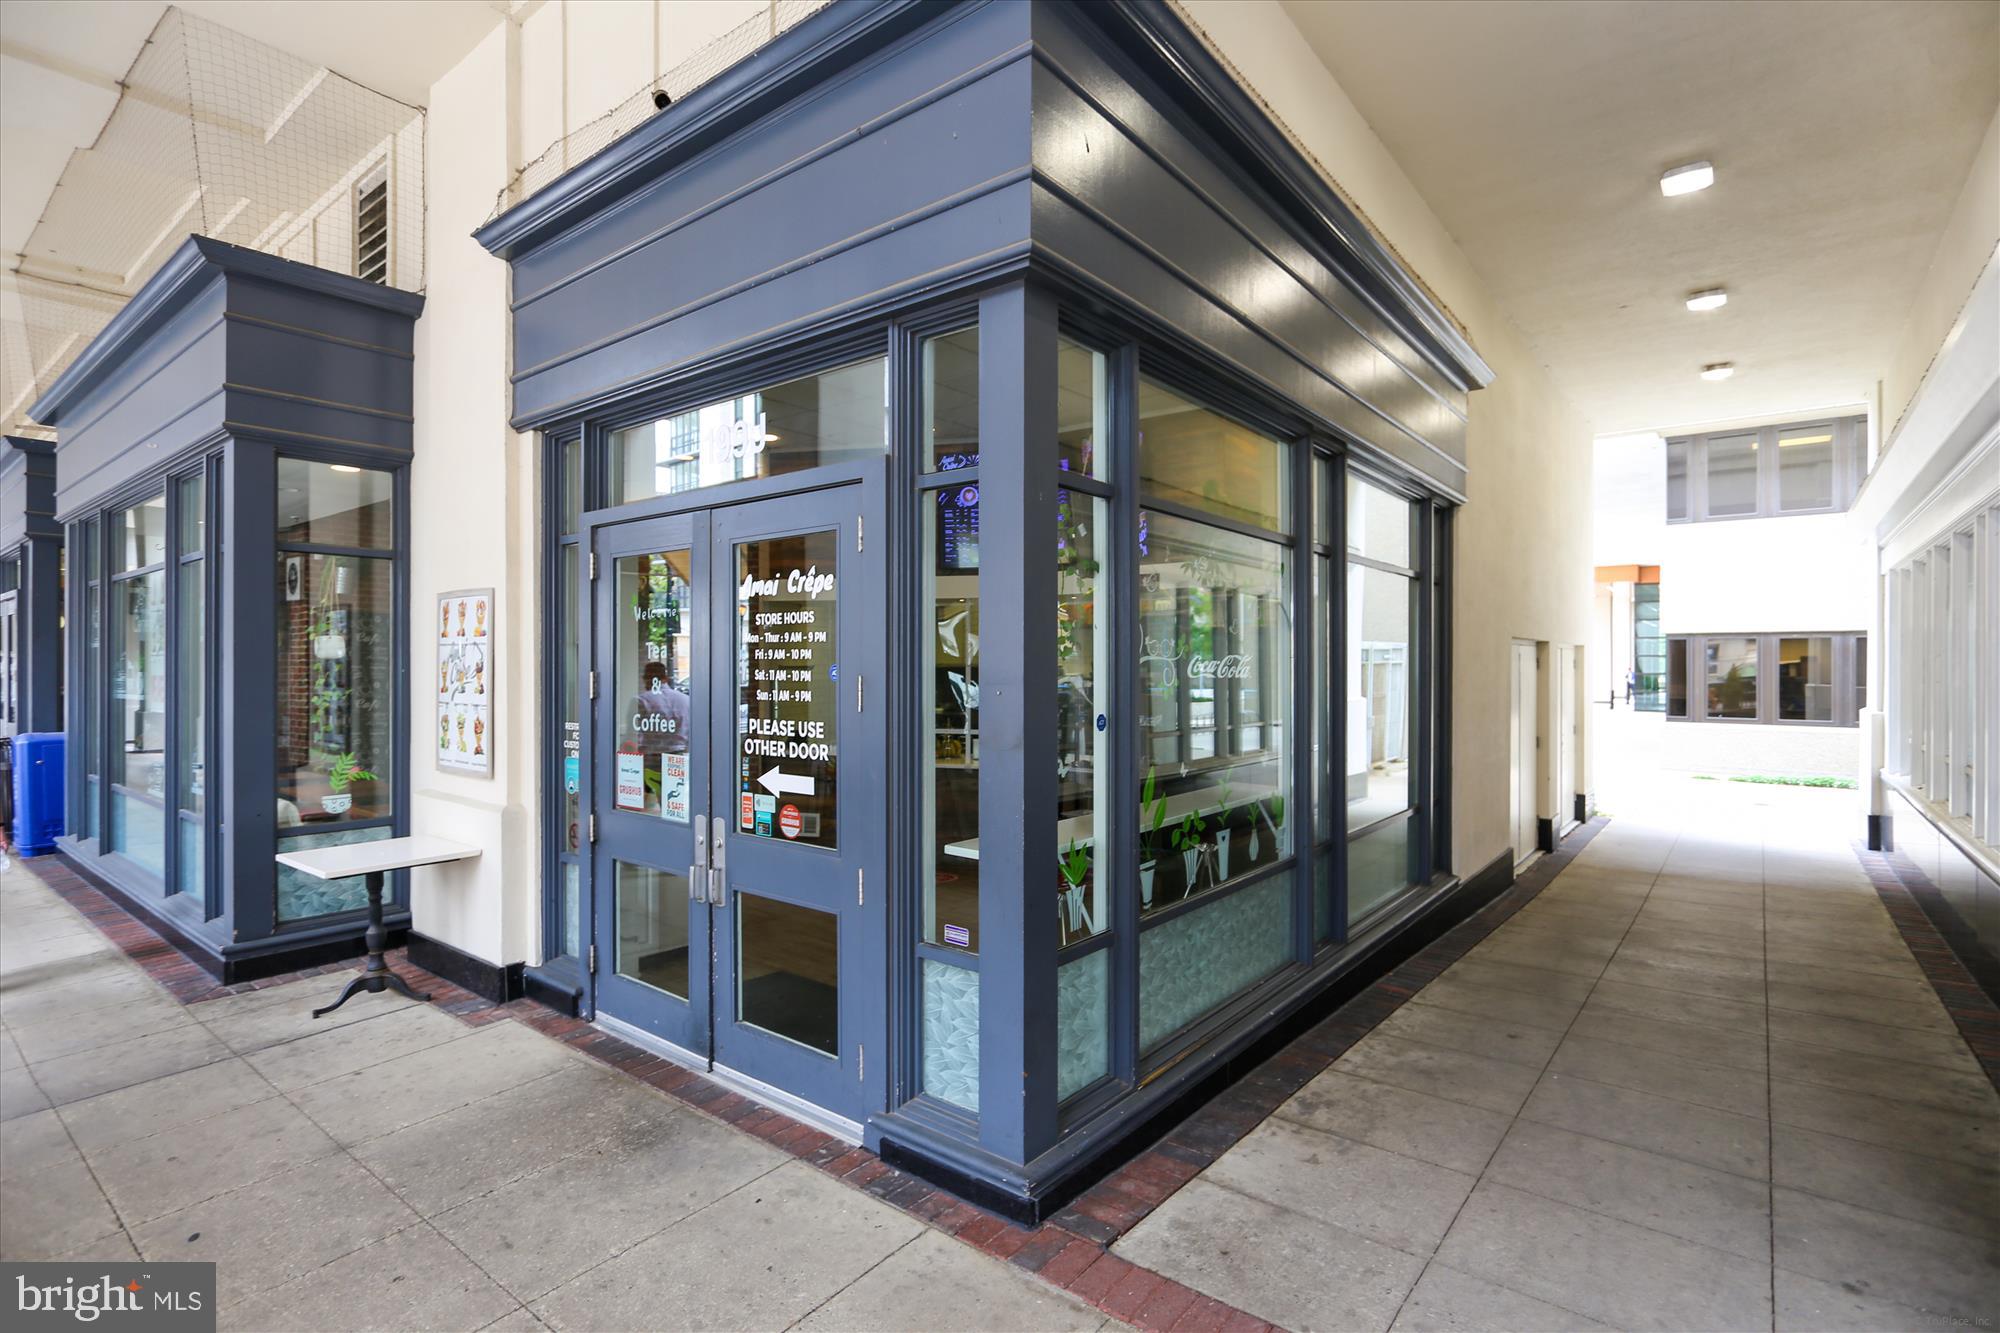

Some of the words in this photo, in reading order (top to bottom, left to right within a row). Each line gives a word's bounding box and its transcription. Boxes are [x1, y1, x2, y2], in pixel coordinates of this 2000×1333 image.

[740, 573, 780, 598] Amai
[787, 565, 834, 599] Crêpe
[633, 605, 677, 621] Welcome
[755, 613, 783, 625] STORE
[783, 611, 815, 624] HOURS
[784, 632, 789, 642] 9
[790, 632, 802, 642] AM
[808, 632, 813, 642] 9
[814, 632, 826, 642] PM
[645, 642, 667, 659] Tea
[754, 649, 764, 659] Fri
[768, 649, 773, 659] 9
[774, 649, 785, 659] AM
[791, 649, 799, 659] 10
[800, 649, 811, 659] PM
[754, 669, 765, 680] Sat
[769, 670, 774, 680] 11
[775, 669, 786, 681] AM
[792, 670, 799, 681] 10
[800, 670, 811, 681] PM
[1187, 654, 1253, 679] Coca-Cola
[651, 677, 661, 695] &
[756, 690, 768, 700] Sun
[779, 690, 789, 701] AM
[795, 690, 800, 701] 9
[800, 690, 811, 702] PM
[632, 713, 676, 732] Coffee
[749, 718, 795, 737] PLEASE
[798, 721, 824, 738] USE
[744, 738, 786, 757] OTHER
[789, 742, 829, 761] DOOR
